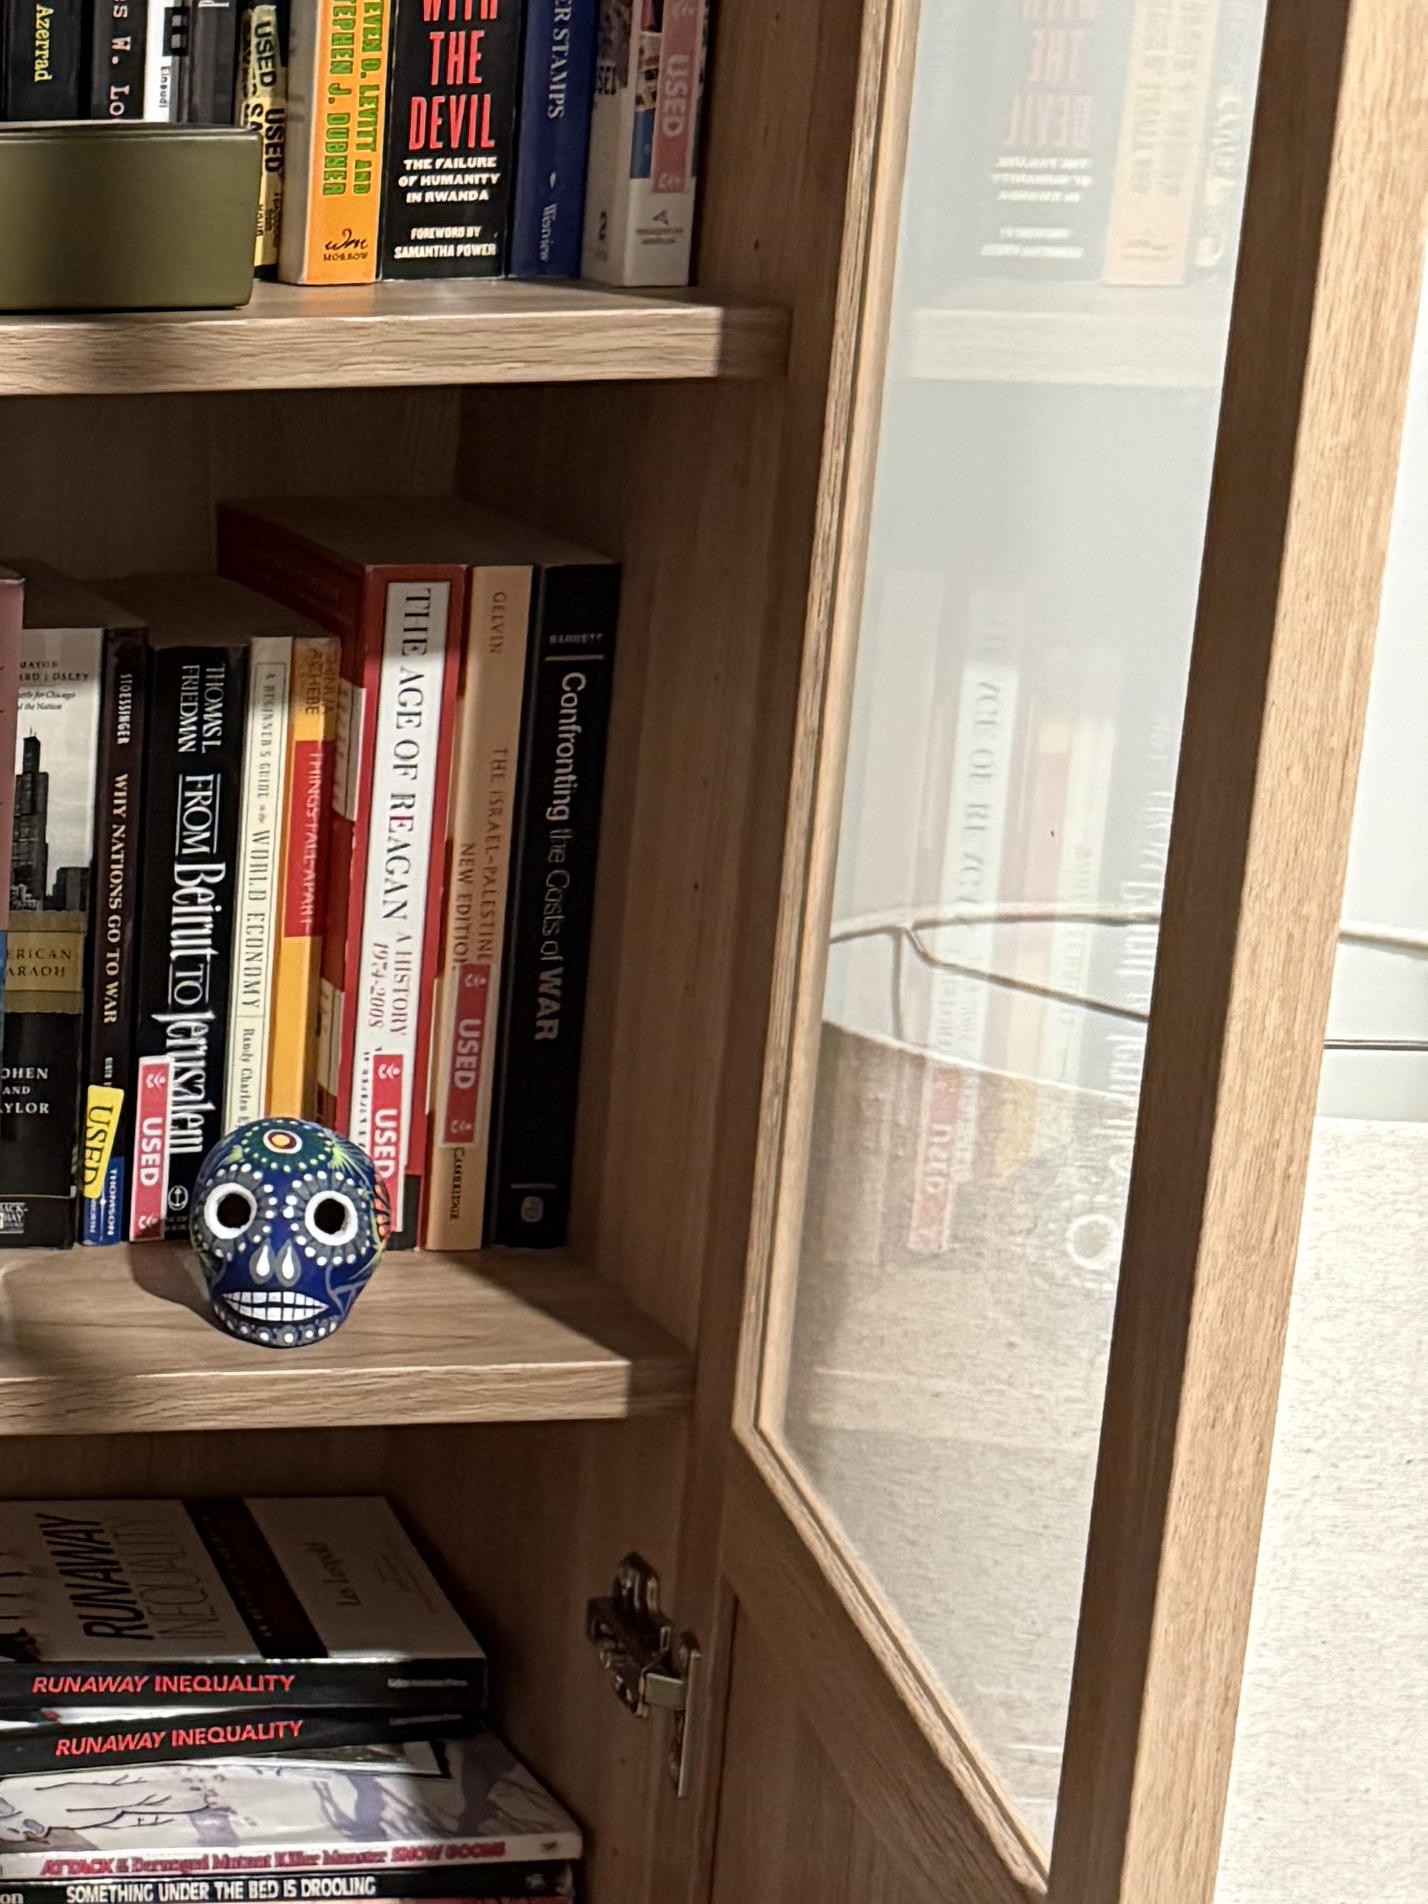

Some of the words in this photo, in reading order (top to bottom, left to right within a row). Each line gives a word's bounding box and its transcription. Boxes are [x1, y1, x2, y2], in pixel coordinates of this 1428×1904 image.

[429, 29, 484, 86] THE
[408, 93, 496, 151] DEVIL
[400, 587, 433, 660] THE
[397, 667, 425, 732] AGE
[393, 737, 420, 779] OF
[380, 791, 417, 924] REAGAN
[32, 1674, 149, 1696] RUNAWAY
[153, 1673, 295, 1695] INEQUALITY
[66, 1881, 152, 1904] SOMETHING
[158, 1880, 208, 1902] UNDER
[212, 1879, 244, 1900] THE
[247, 1878, 281, 1900] BED
[283, 1877, 298, 1899] IS
[301, 1874, 378, 1898] DROOLING
